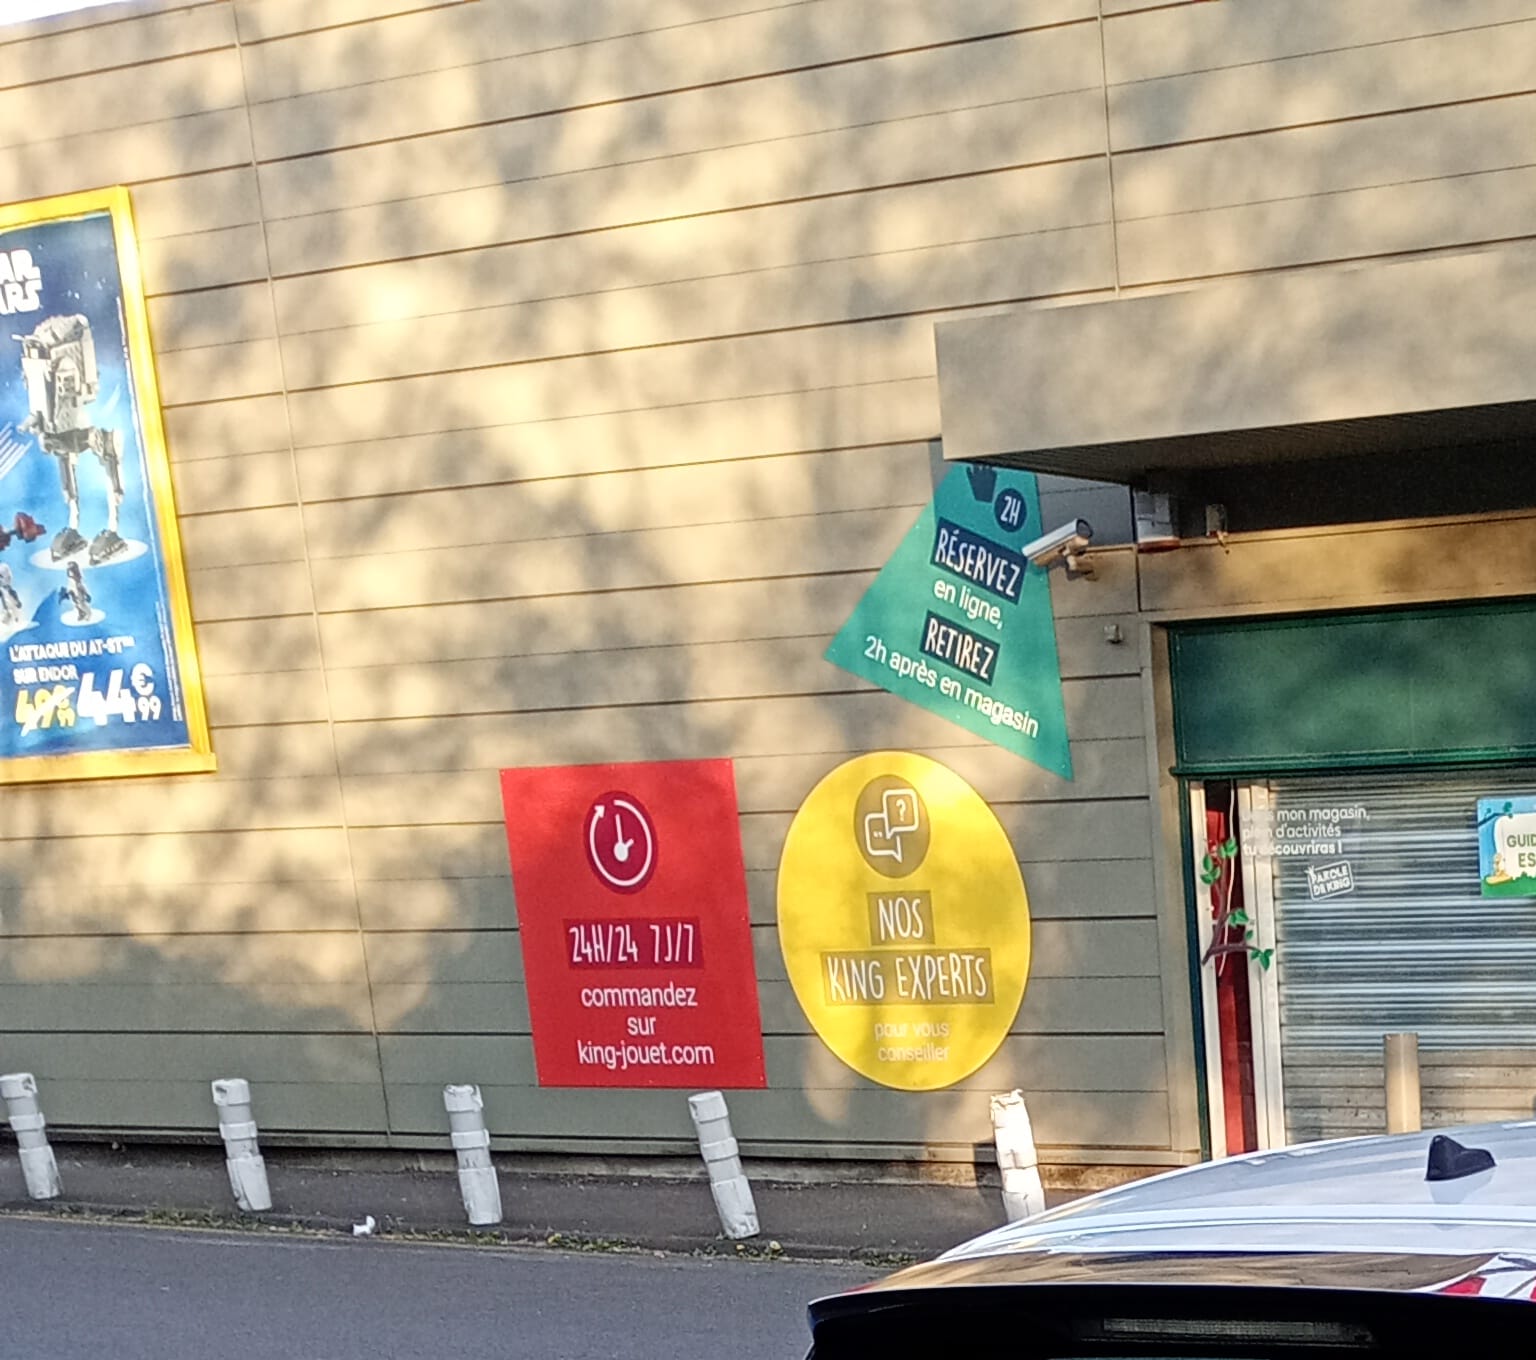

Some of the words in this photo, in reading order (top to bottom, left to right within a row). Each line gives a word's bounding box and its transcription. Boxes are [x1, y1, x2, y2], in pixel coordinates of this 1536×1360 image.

[999, 495, 1022, 525] 2H
[935, 528, 1021, 597] RÉSERVEZ
[934, 579, 956, 603] en
[958, 585, 1003, 630] ligne,
[924, 617, 995, 681] RETIREZ
[13, 667, 38, 685] SUR
[38, 664, 79, 684] ENDOR
[864, 635, 887, 664] 2h
[889, 650, 937, 690] après
[940, 674, 963, 698] en
[964, 687, 1040, 739] magasin
[1277, 808, 1307, 821] mon
[1308, 804, 1370, 823] magasin,
[1275, 822, 1342, 839] d'activités
[878, 896, 924, 941] NOS
[568, 924, 639, 964] 24H/24
[650, 922, 695, 964] 7J/7
[826, 955, 885, 1001] KING
[895, 952, 988, 1001] EXPERTS
[580, 981, 699, 1008] commandez
[627, 1016, 656, 1036] sur
[874, 1022, 909, 1041] pour
[911, 1021, 950, 1038] vous
[577, 1039, 715, 1070] king-jouet.com
[877, 1041, 952, 1063] conseiller
